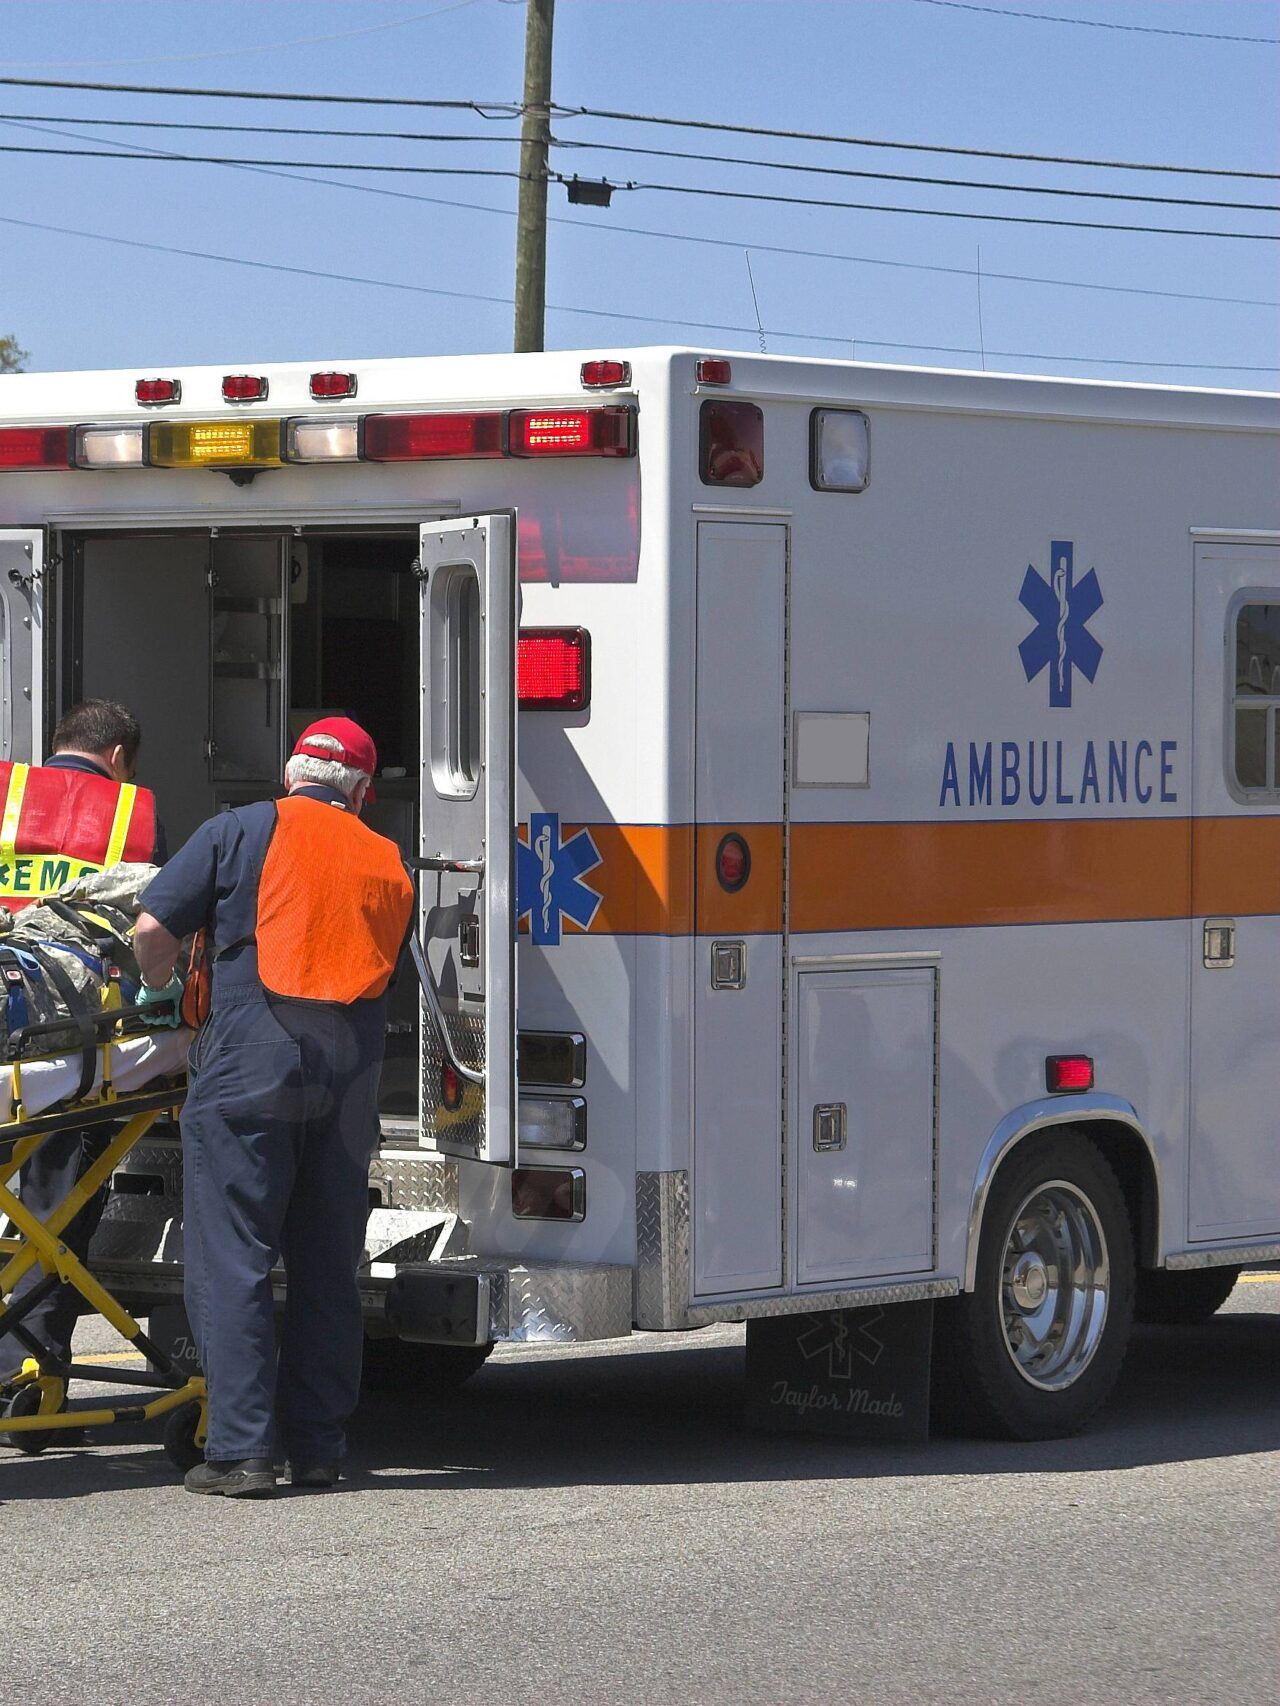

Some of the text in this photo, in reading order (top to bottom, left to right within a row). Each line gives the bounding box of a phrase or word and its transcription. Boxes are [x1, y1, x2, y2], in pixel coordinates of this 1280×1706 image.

[939, 740, 1177, 807] AMBULANCE
[14, 860, 100, 891] EM
[771, 1380, 905, 1417] Taylor Made
